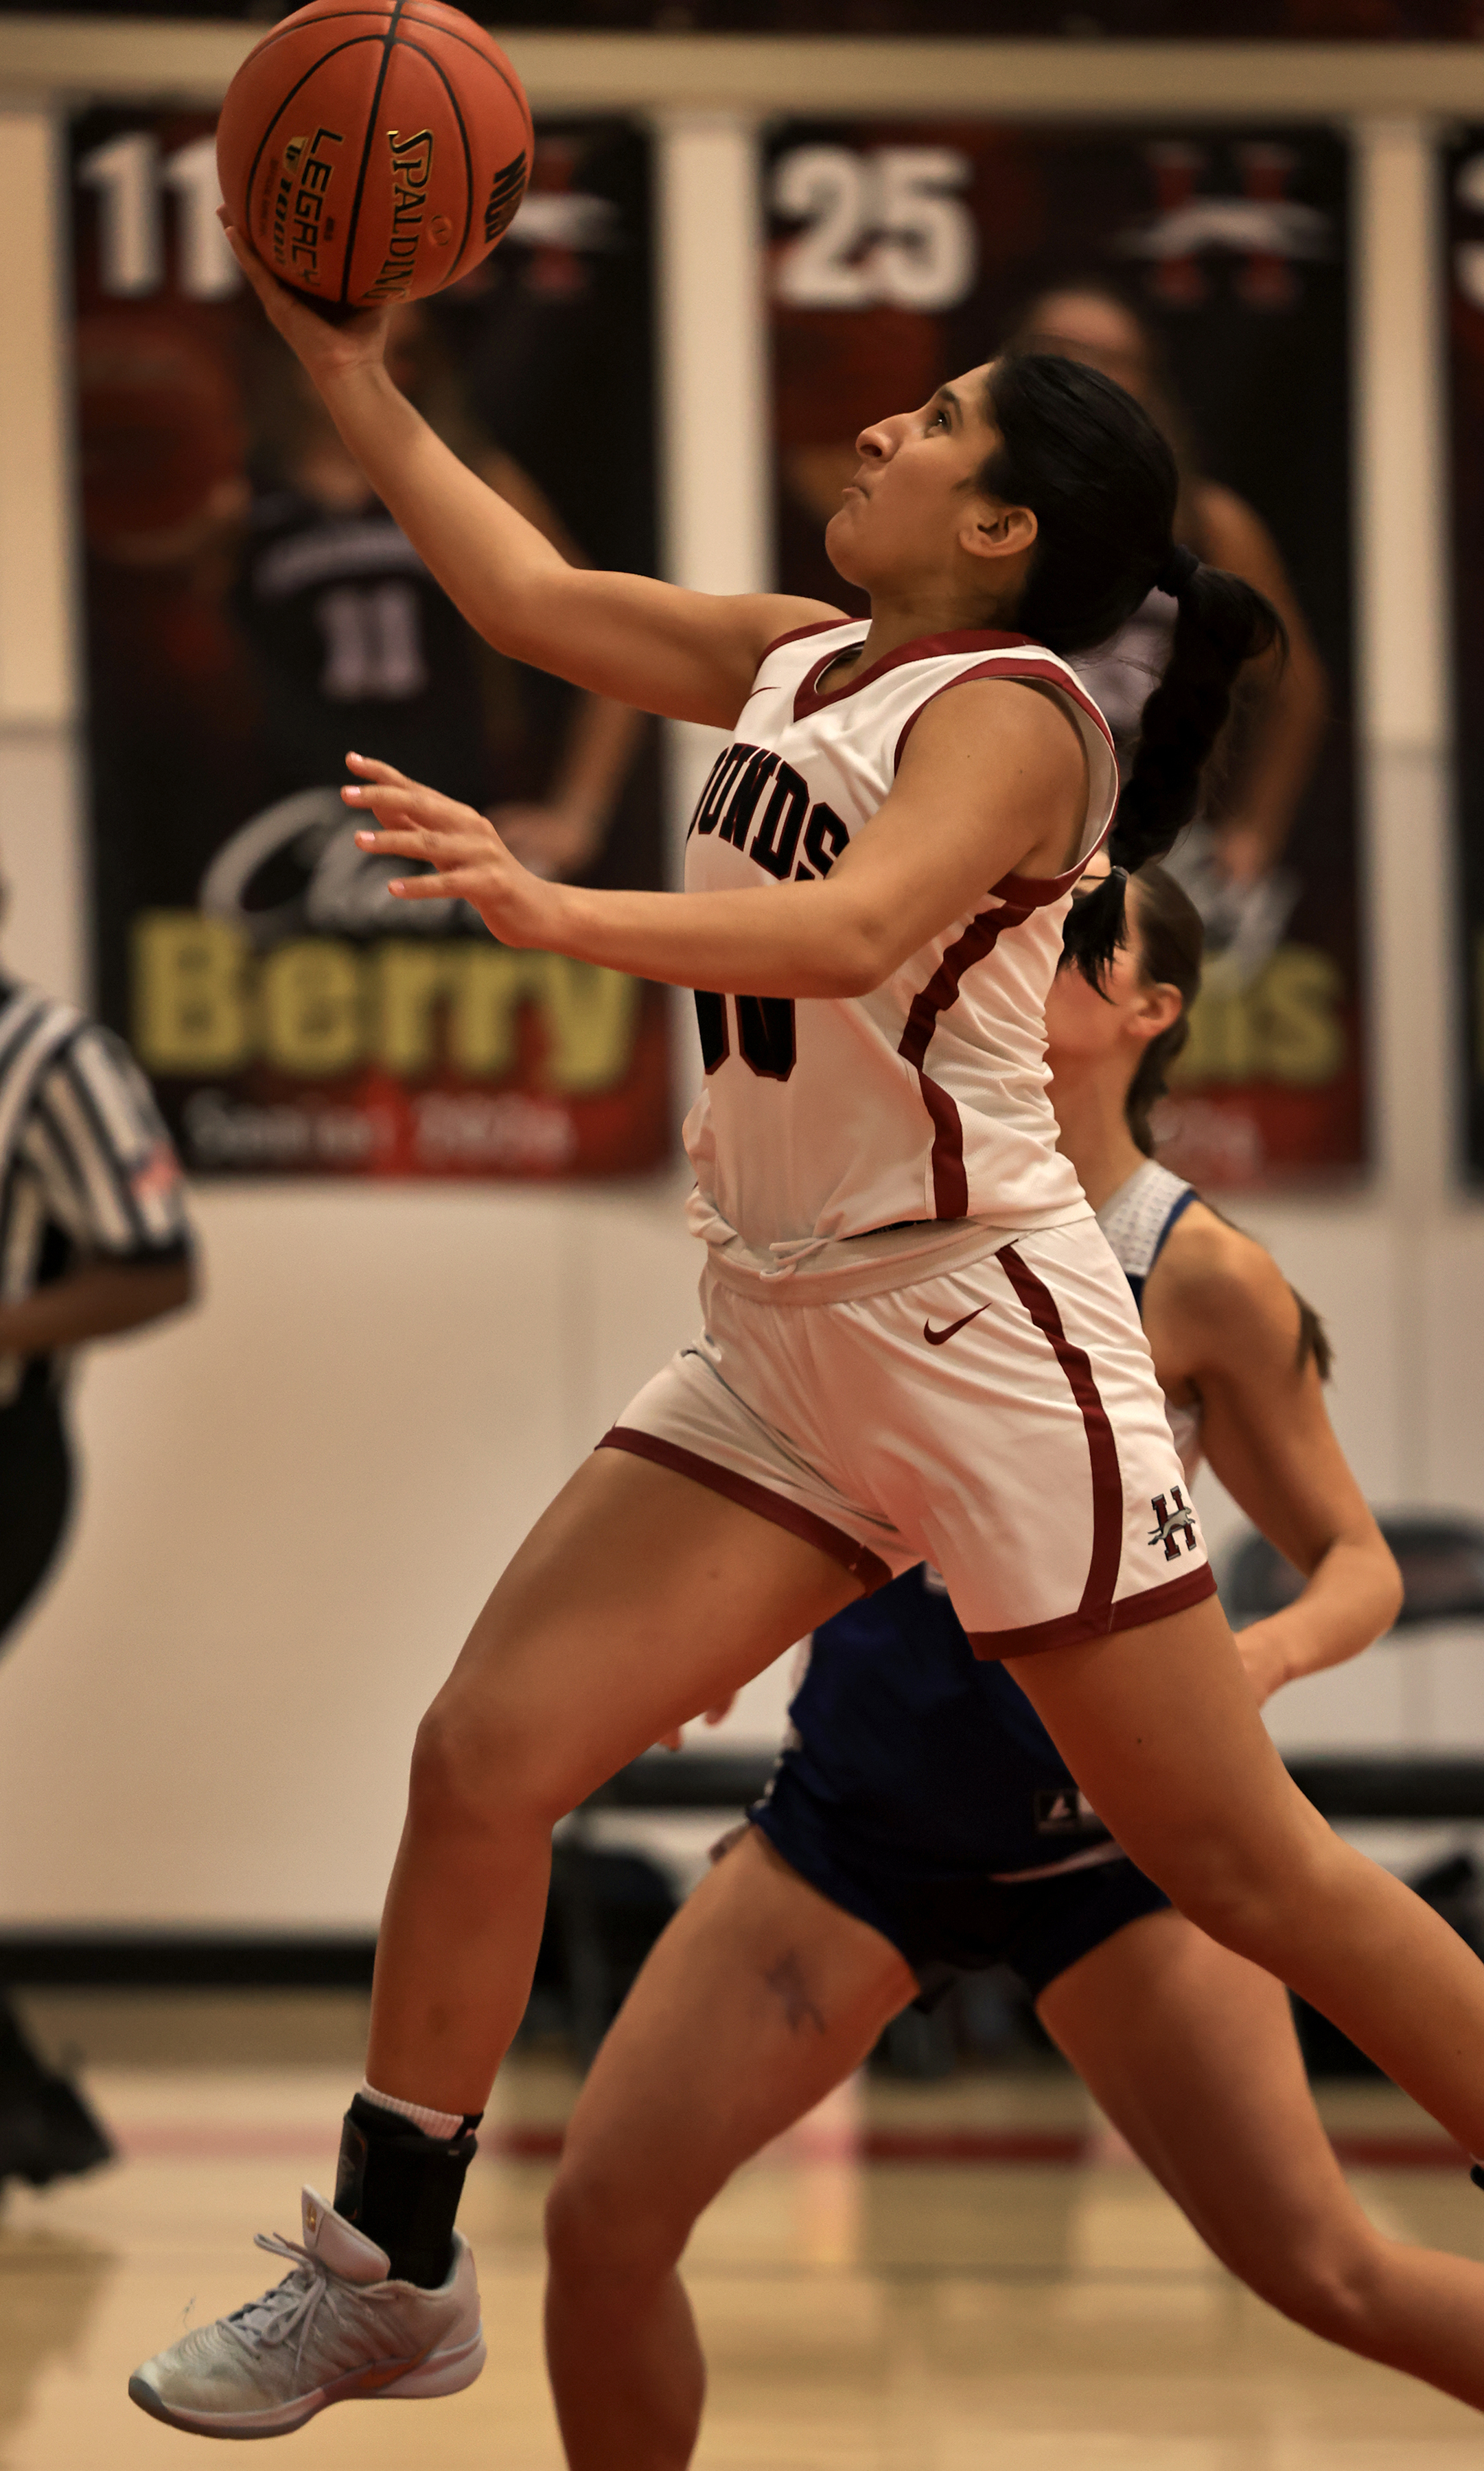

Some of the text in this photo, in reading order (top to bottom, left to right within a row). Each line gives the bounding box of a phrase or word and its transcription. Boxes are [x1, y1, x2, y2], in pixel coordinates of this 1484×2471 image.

[292, 128, 343, 287] LEGACY
[361, 129, 434, 300] SPALDING
[772, 143, 977, 311] 25
[686, 743, 850, 881] UNDS
[136, 914, 631, 1087] Berry
